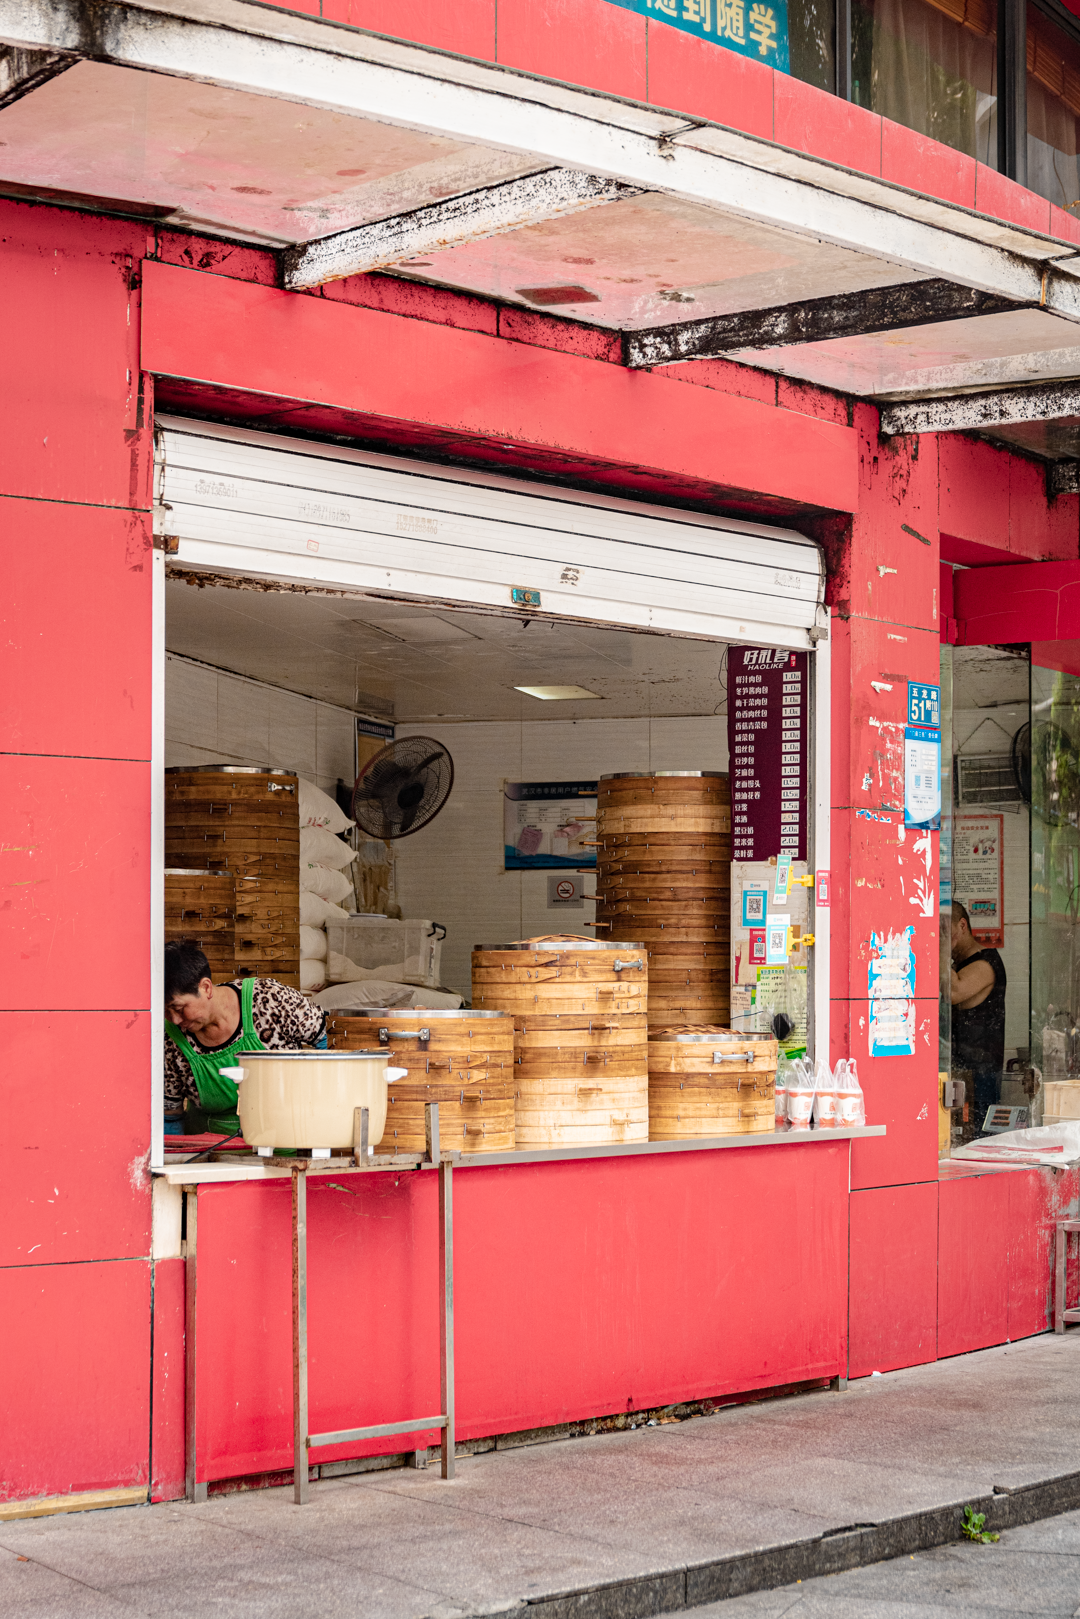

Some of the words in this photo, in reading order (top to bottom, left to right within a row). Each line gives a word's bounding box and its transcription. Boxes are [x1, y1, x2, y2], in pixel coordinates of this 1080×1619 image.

[912, 688, 937, 700] 五龙路
[911, 699, 925, 721] 51
[734, 757, 755, 765] 豆沙包
